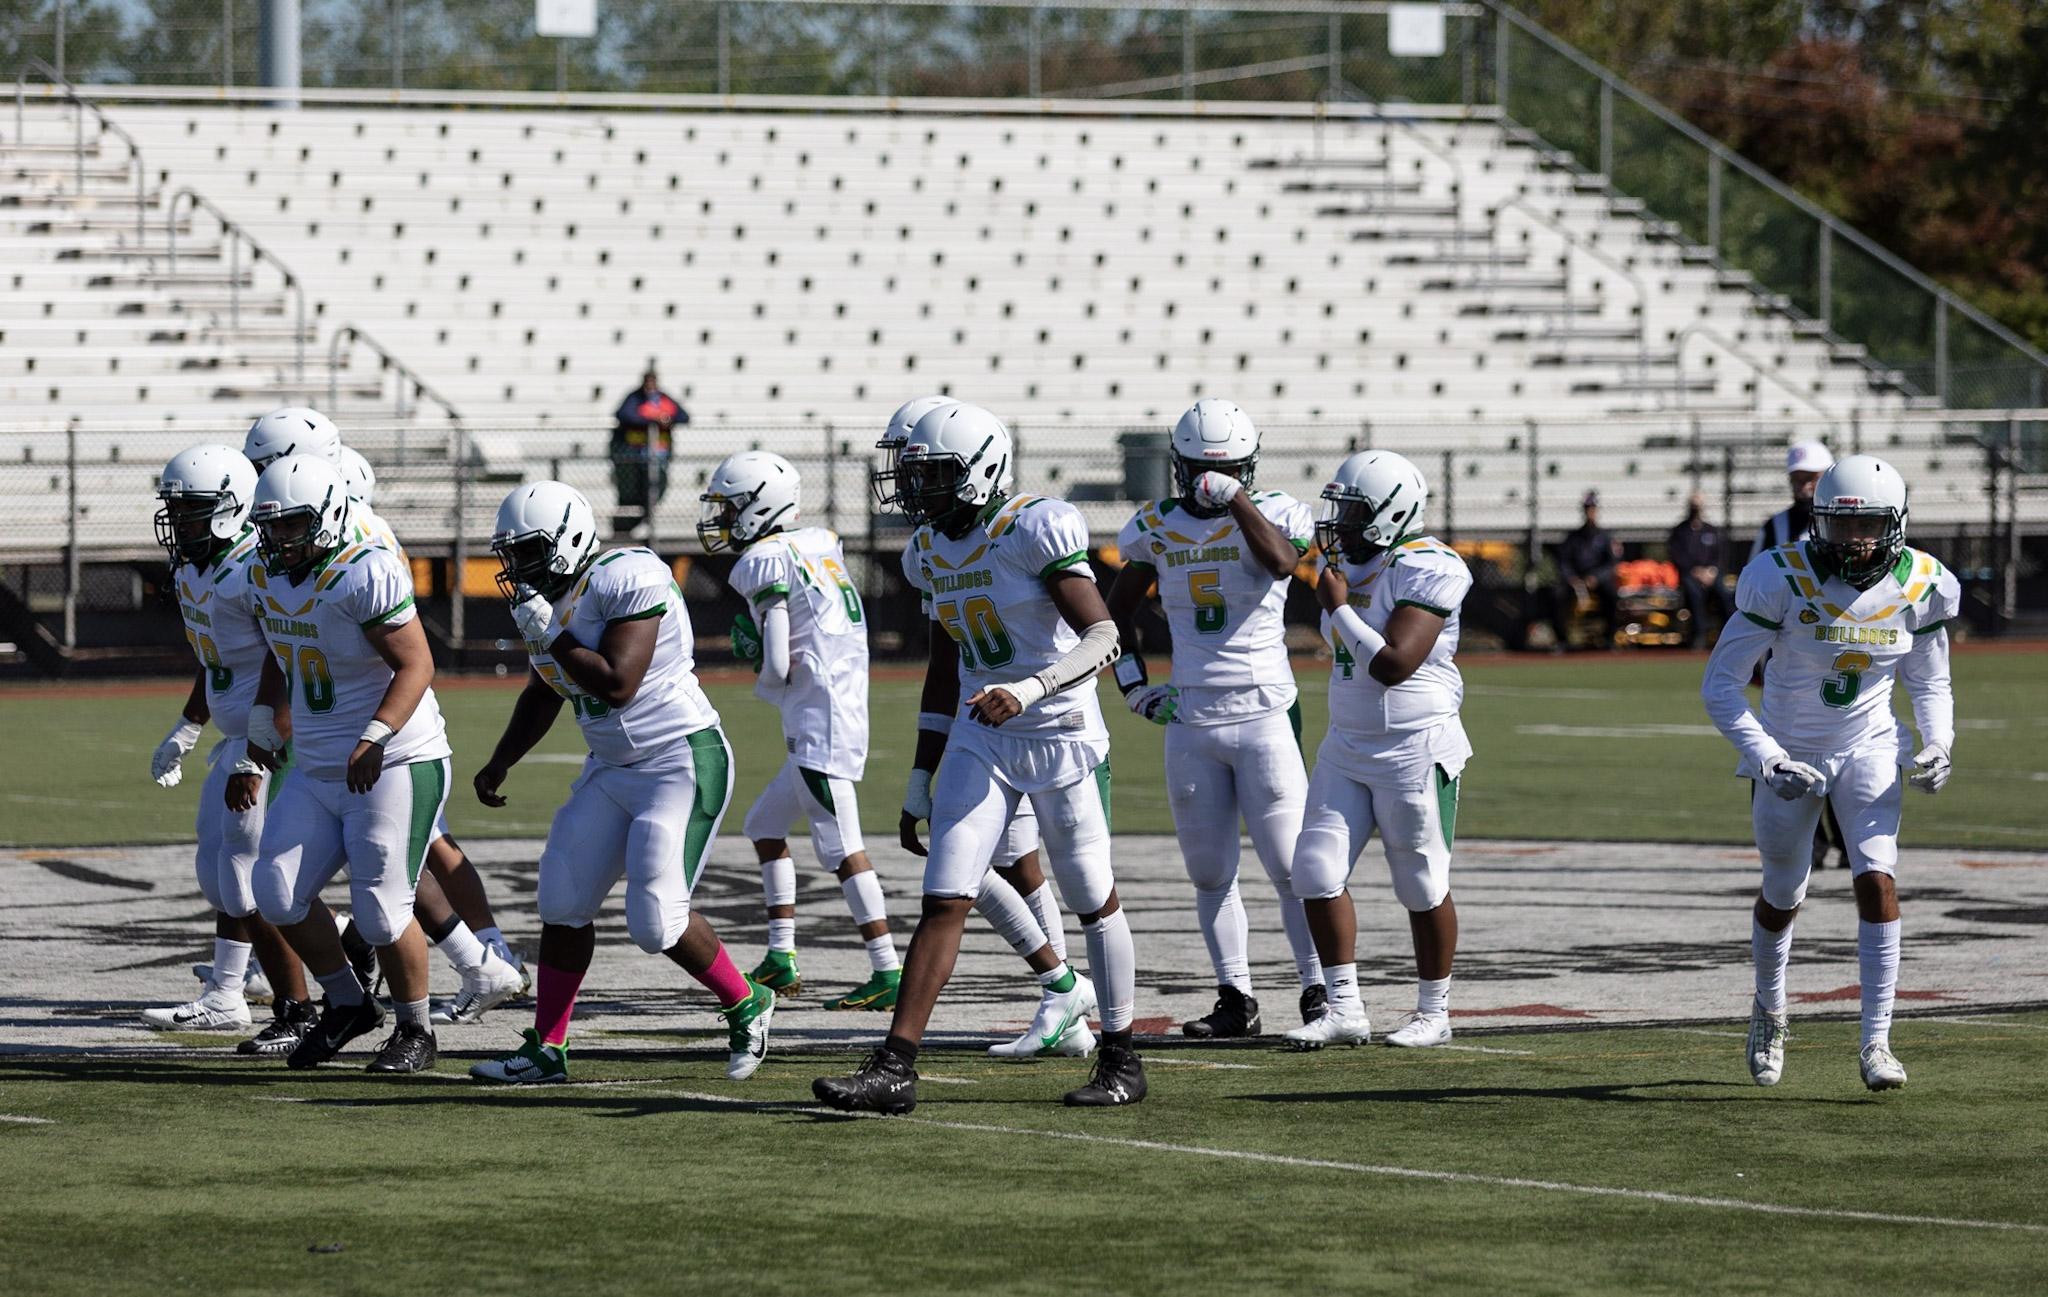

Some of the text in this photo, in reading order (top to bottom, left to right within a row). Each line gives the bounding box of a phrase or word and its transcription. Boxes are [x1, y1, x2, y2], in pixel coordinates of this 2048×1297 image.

[930, 568, 993, 595] BULLDOGS
[1166, 545, 1240, 568] BULLDOGS
[1187, 568, 1229, 635] 5
[935, 593, 1017, 673] 50
[1331, 624, 1356, 681] 4
[1814, 624, 1898, 646] BULLDOGS
[271, 639, 337, 715] 70
[1819, 649, 1873, 710] 3
